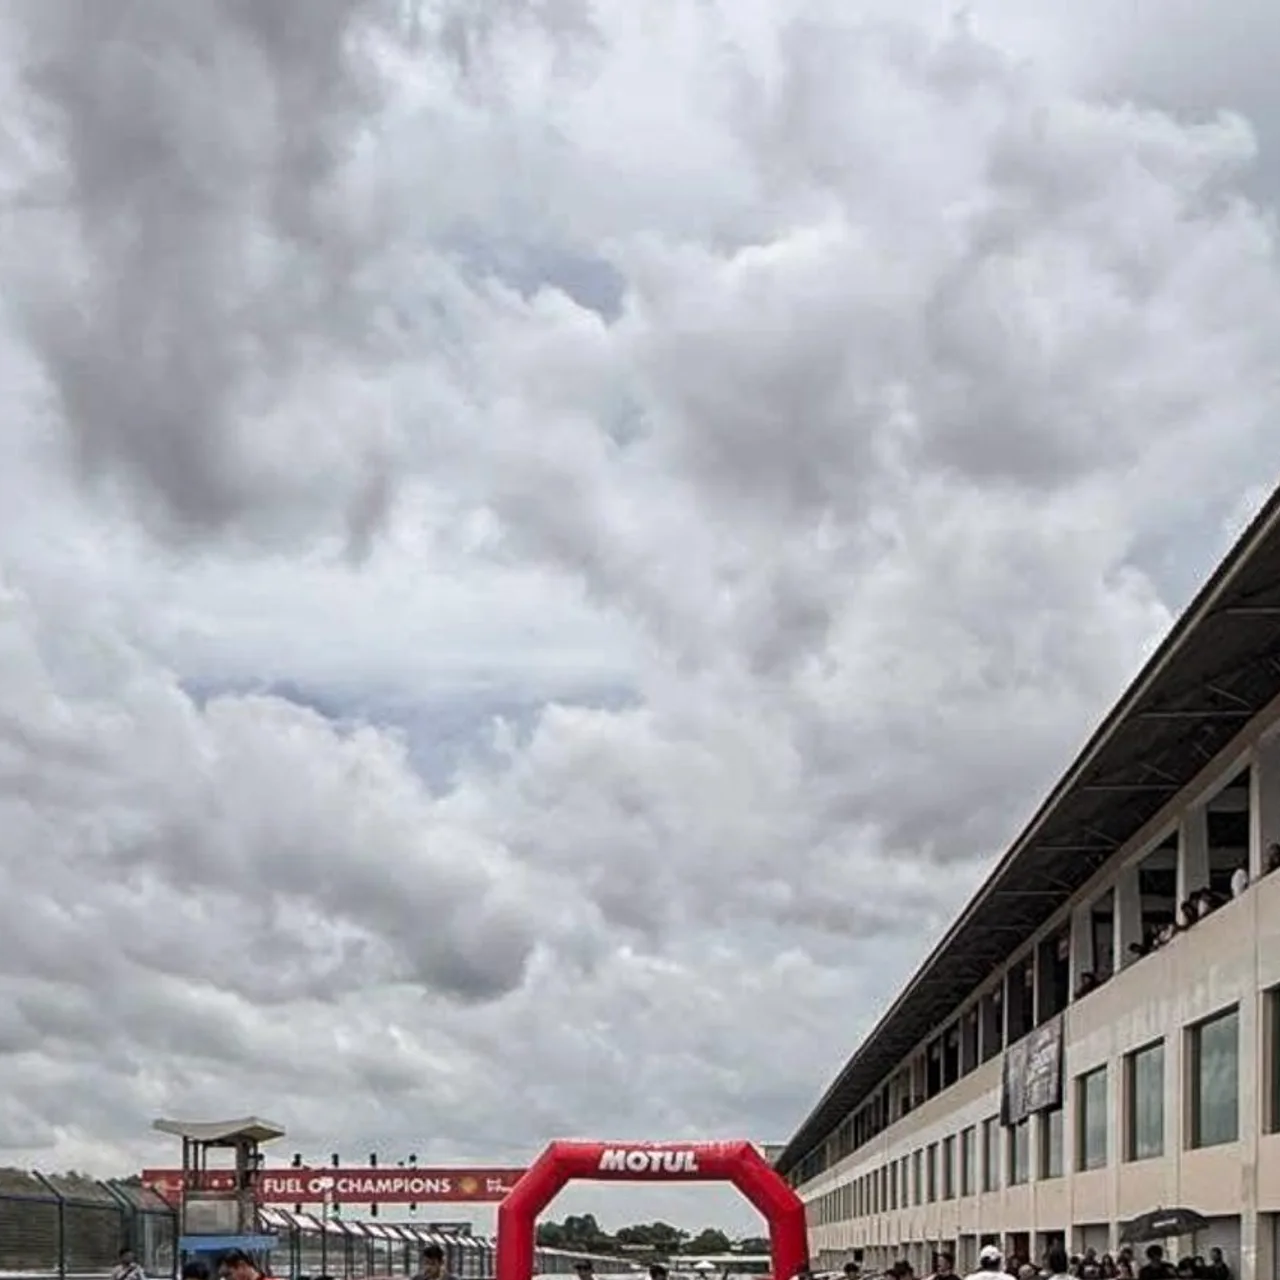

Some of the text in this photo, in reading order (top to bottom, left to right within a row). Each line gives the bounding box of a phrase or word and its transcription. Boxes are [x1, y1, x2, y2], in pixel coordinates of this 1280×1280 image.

[599, 1149, 698, 1172] MOTUL
[263, 1178, 451, 1193] FUEL O CHAMPIONS
